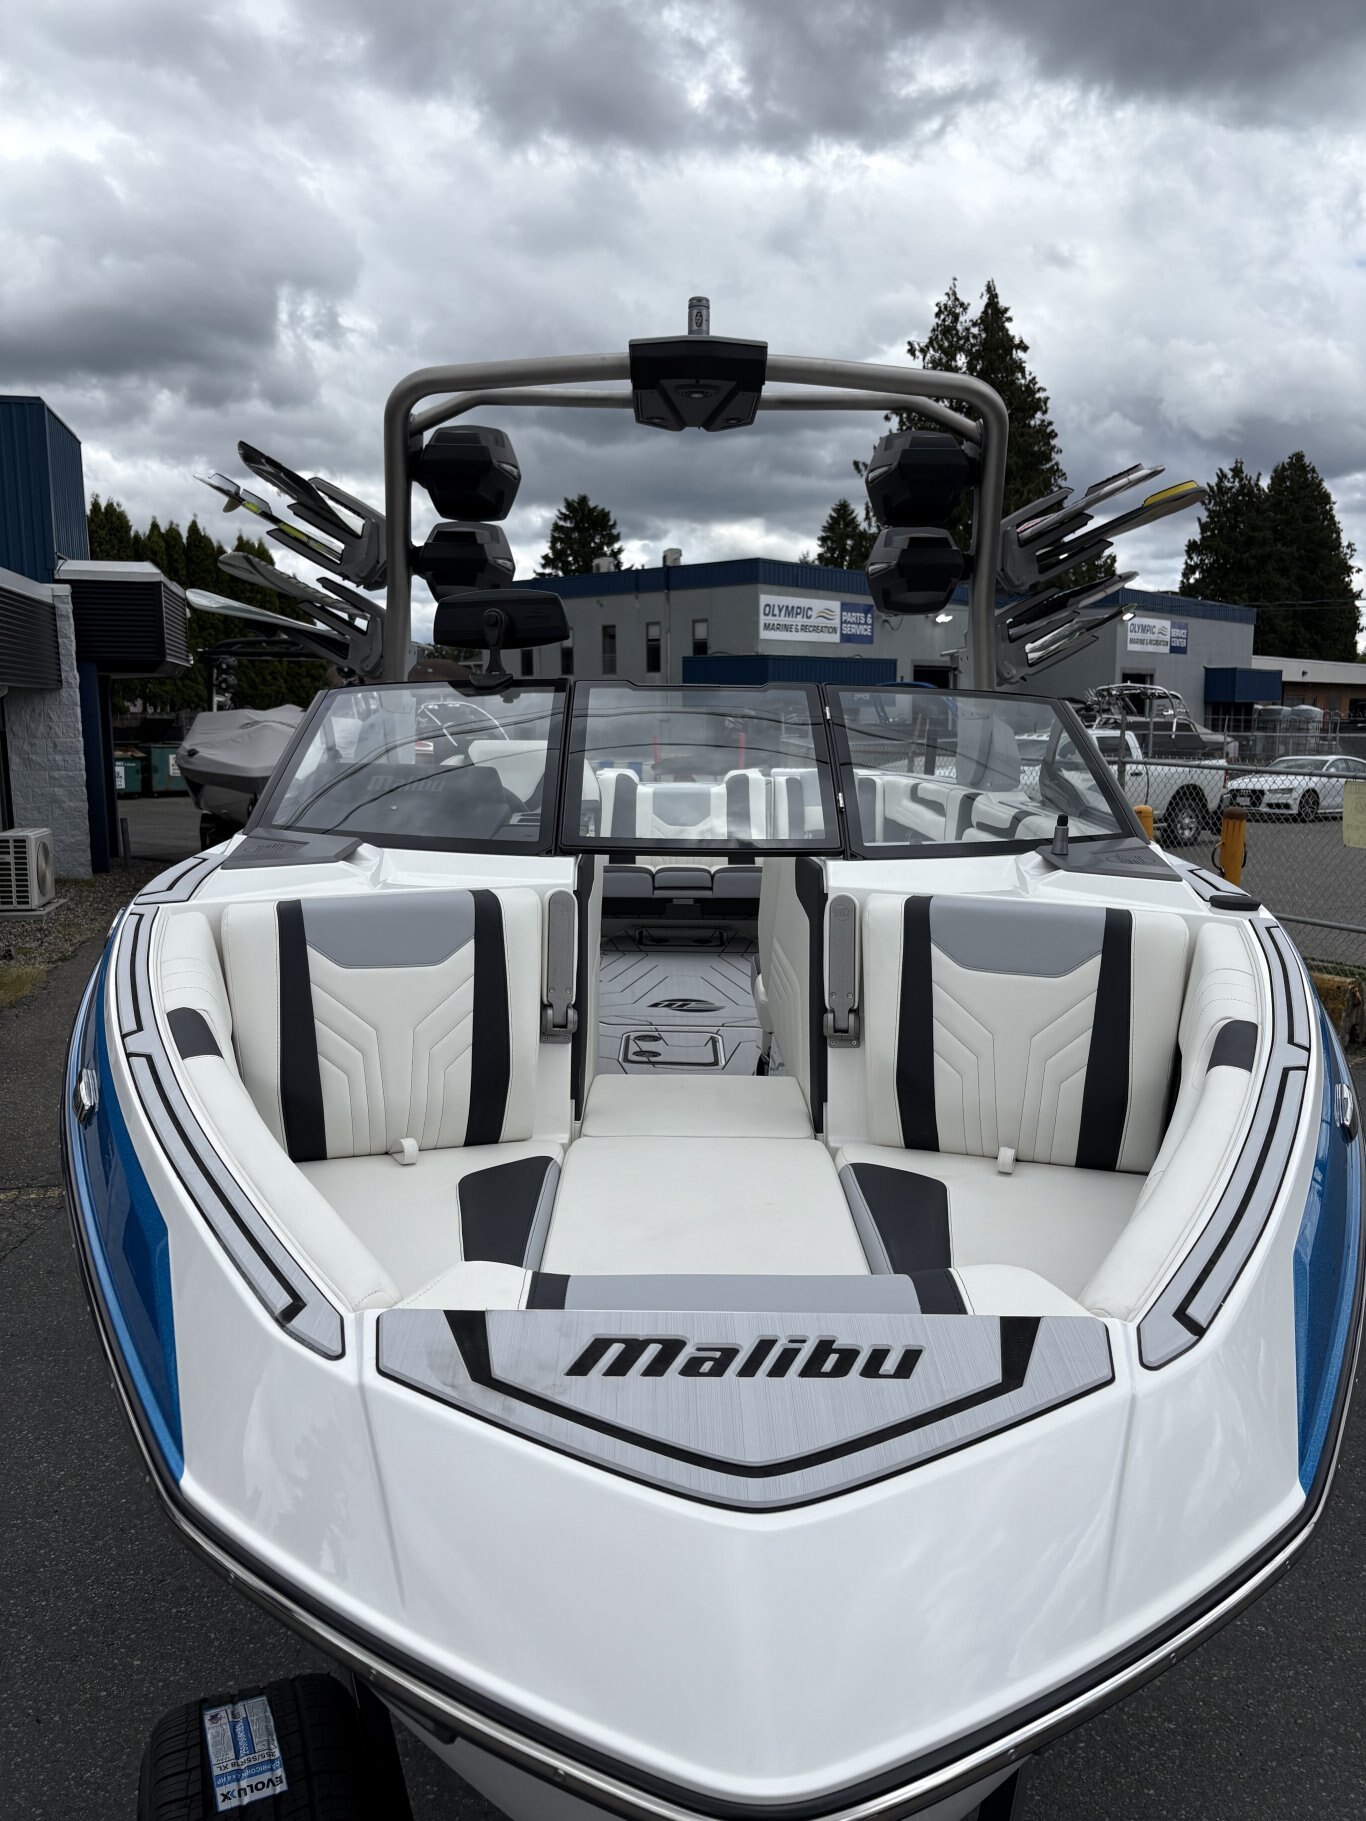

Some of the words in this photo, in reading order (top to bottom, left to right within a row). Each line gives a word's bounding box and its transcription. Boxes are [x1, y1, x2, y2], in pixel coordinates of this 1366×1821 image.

[763, 603, 813, 619] OLYMPIC
[842, 612, 865, 624] PARTS
[866, 614, 872, 624] &
[763, 622, 793, 633] MARINE
[795, 625, 799, 633] &
[800, 625, 837, 635] RECREATION
[842, 625, 872, 636] SERVICE
[1129, 623, 1156, 635] OLYMPIC
[1171, 628, 1187, 638] SERVICE
[1129, 637, 1145, 646] MARINE
[1171, 638, 1187, 647] CENTER
[217, 1764, 229, 1772] XL
